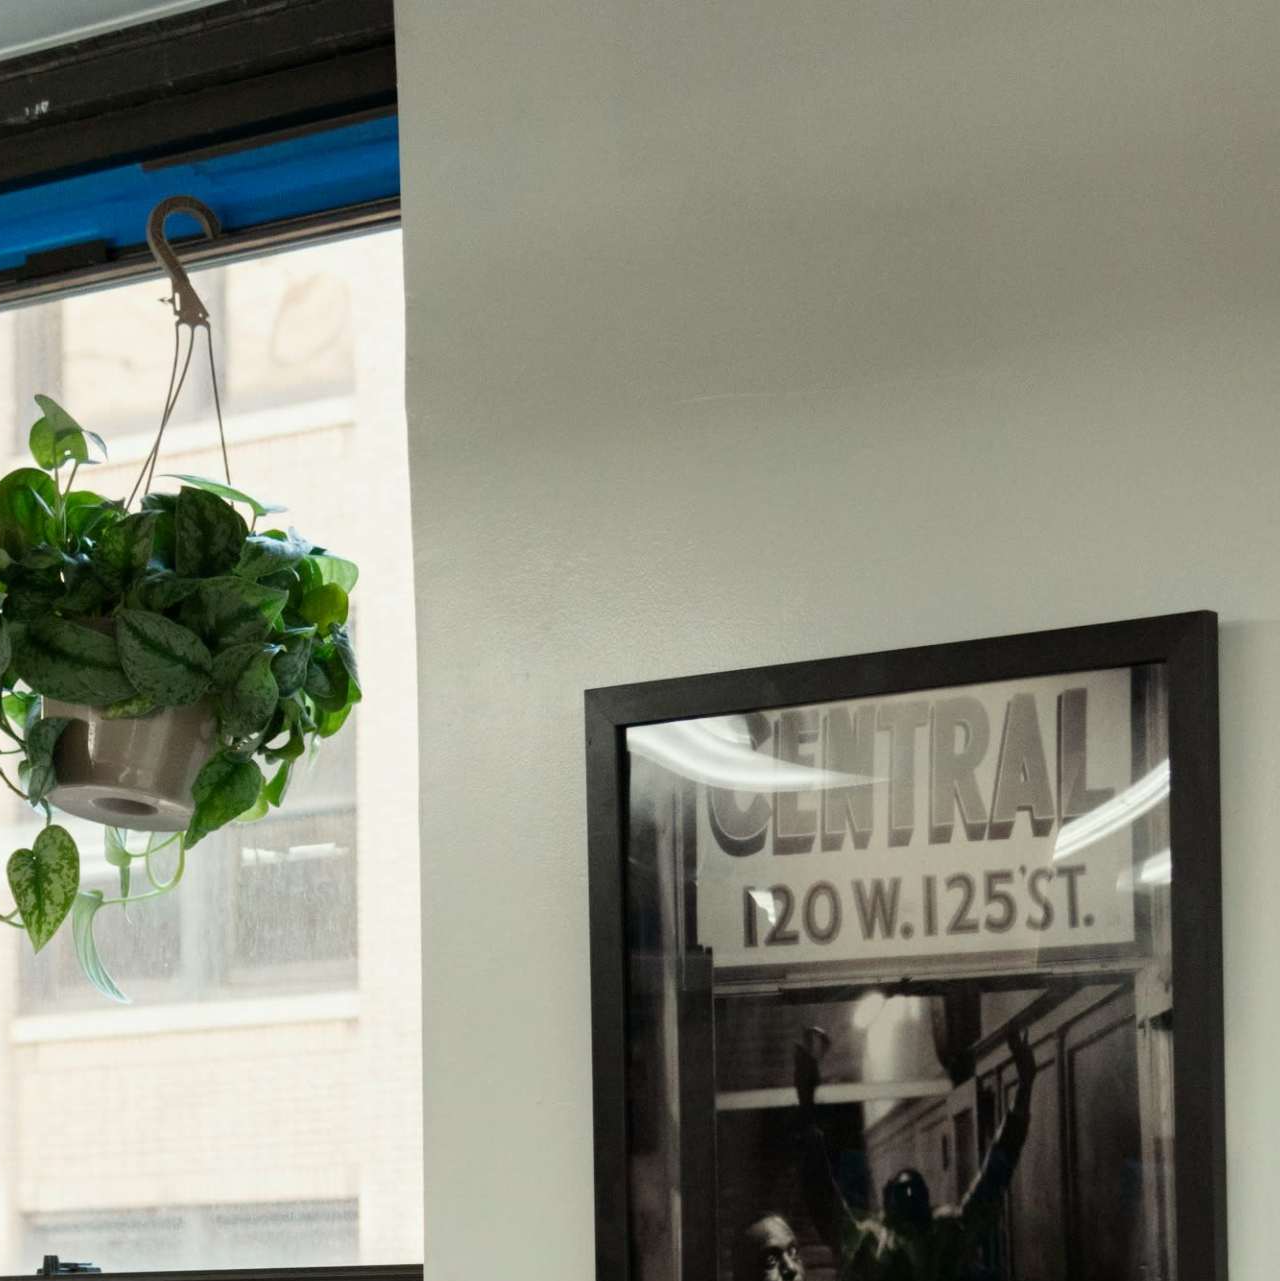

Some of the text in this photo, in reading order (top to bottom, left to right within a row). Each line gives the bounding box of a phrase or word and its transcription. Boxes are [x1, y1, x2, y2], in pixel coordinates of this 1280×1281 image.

[705, 686, 1116, 858] CENTRAL
[743, 880, 843, 948] 120
[850, 876, 914, 940] W.
